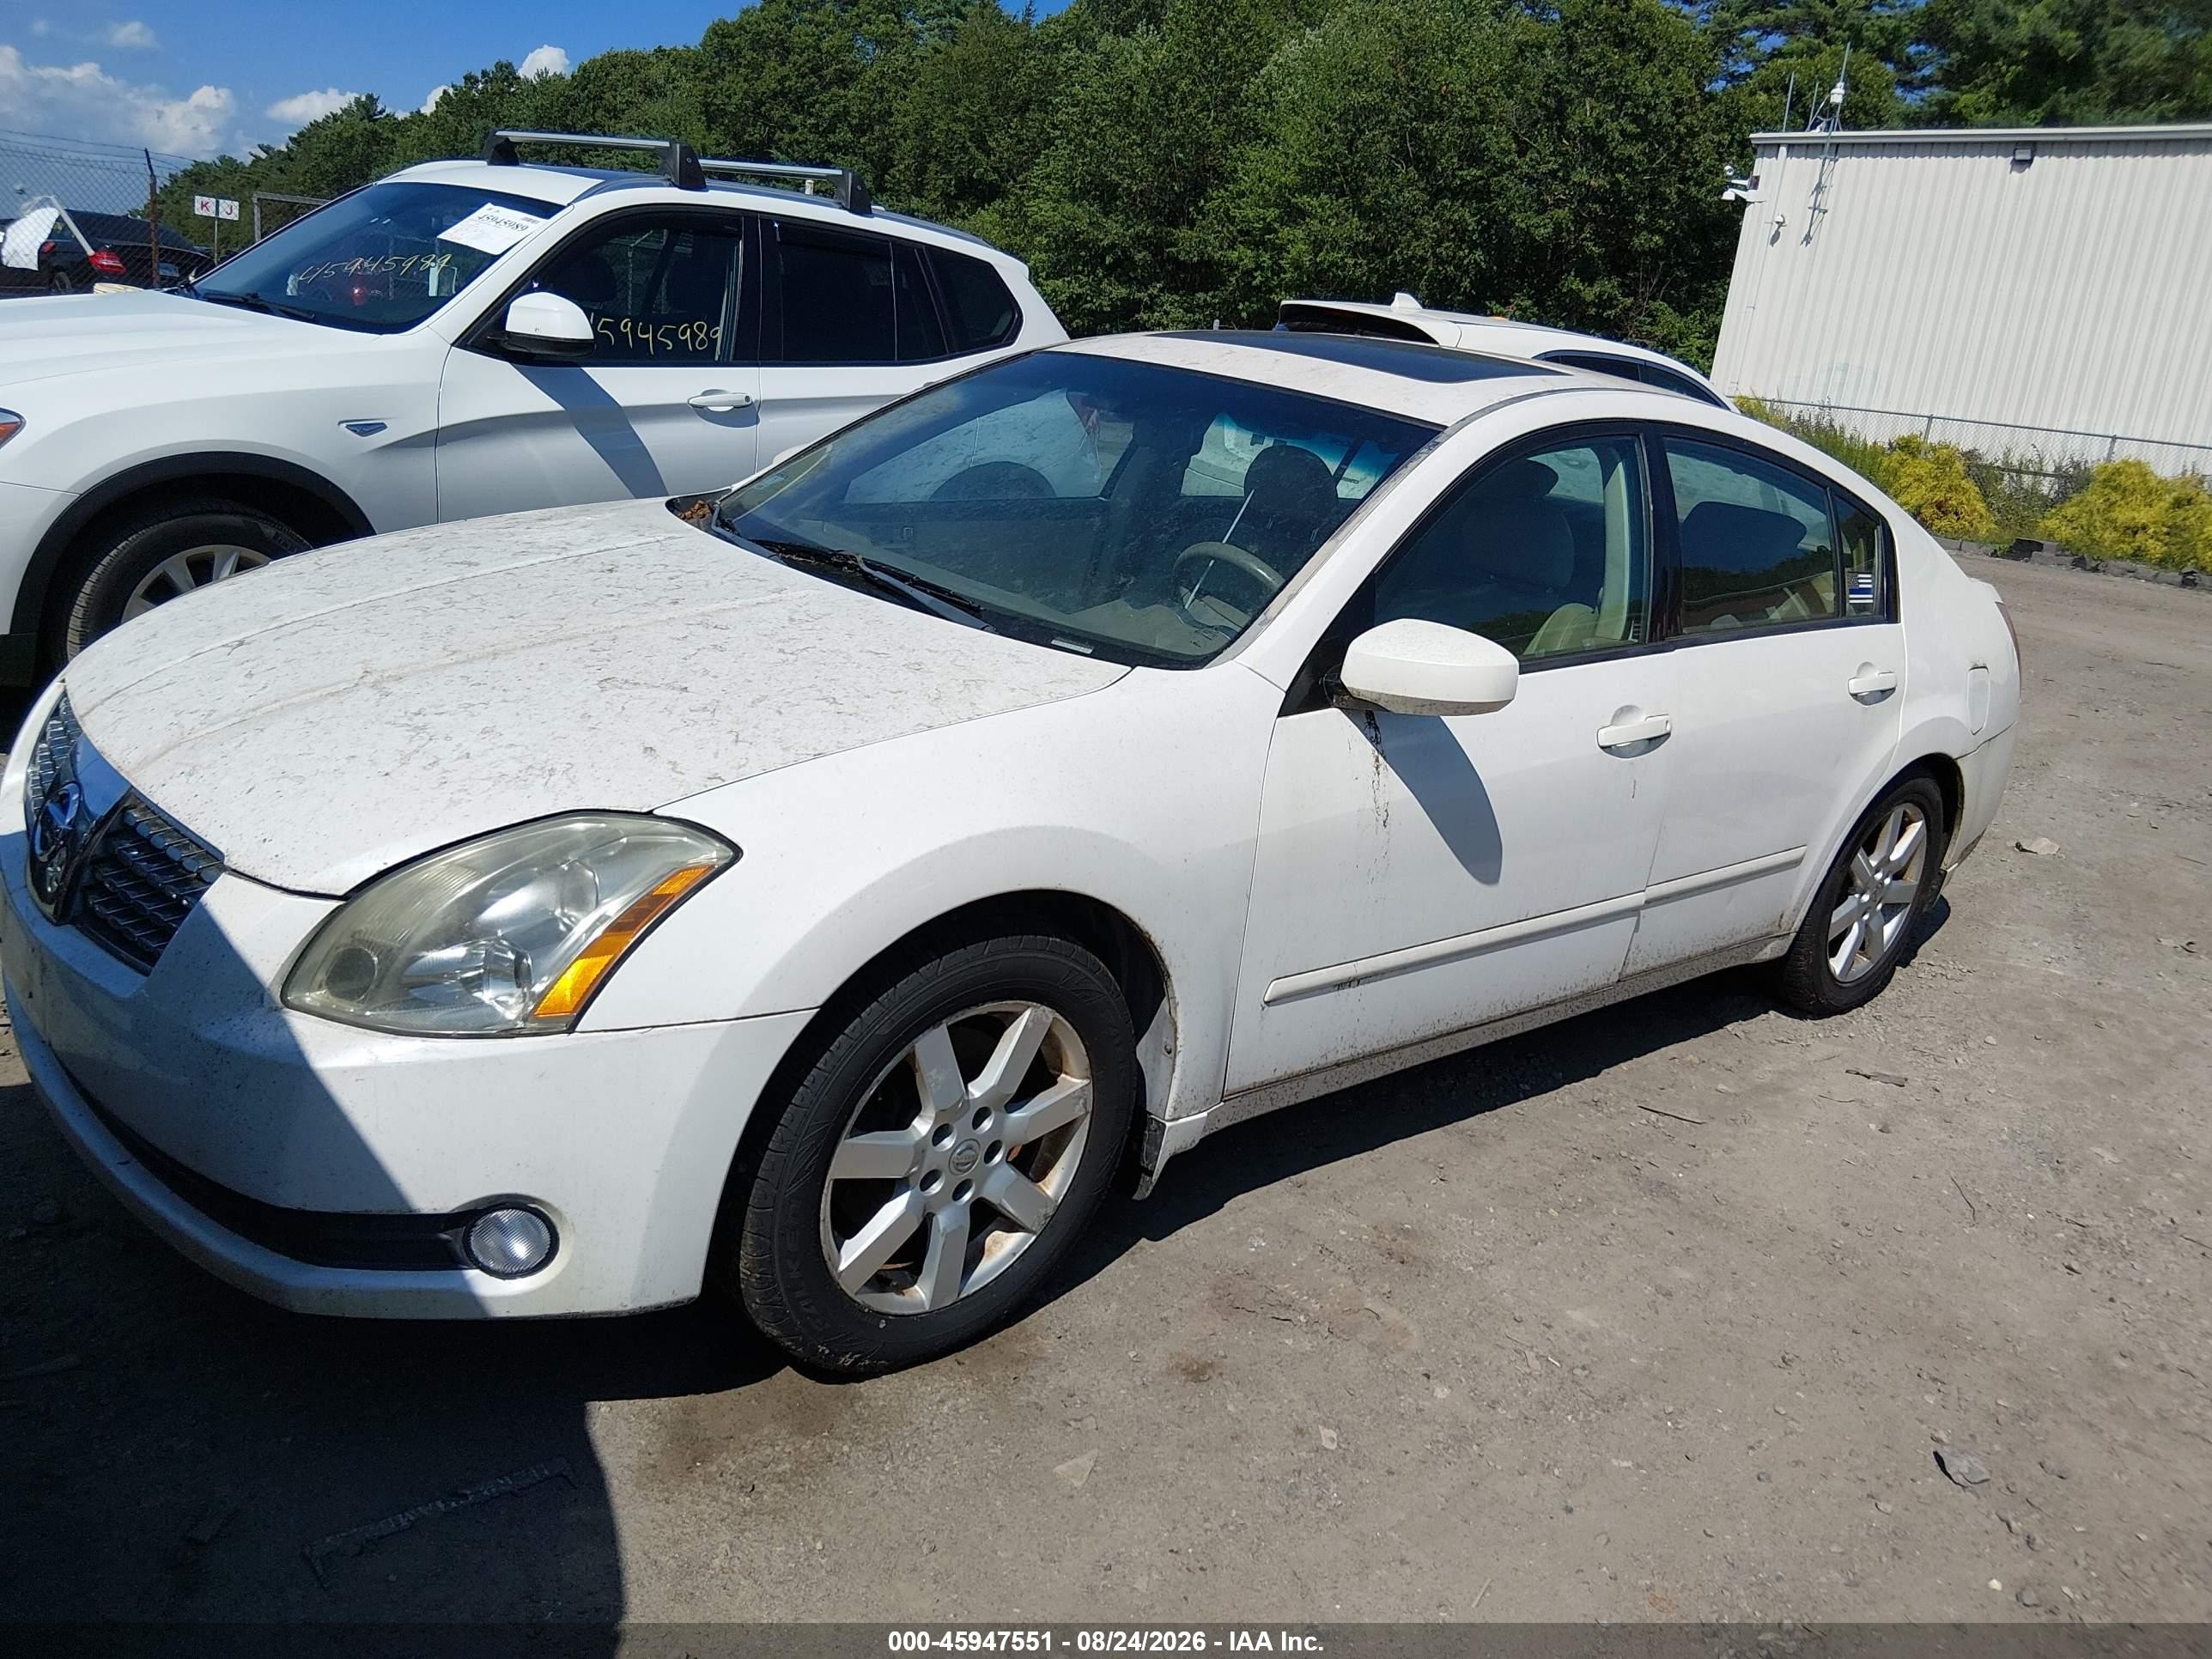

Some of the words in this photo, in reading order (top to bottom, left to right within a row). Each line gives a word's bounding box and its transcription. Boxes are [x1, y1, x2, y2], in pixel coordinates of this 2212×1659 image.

[200, 200, 210, 213] K
[225, 205, 234, 216] J
[590, 312, 722, 358] 5945989
